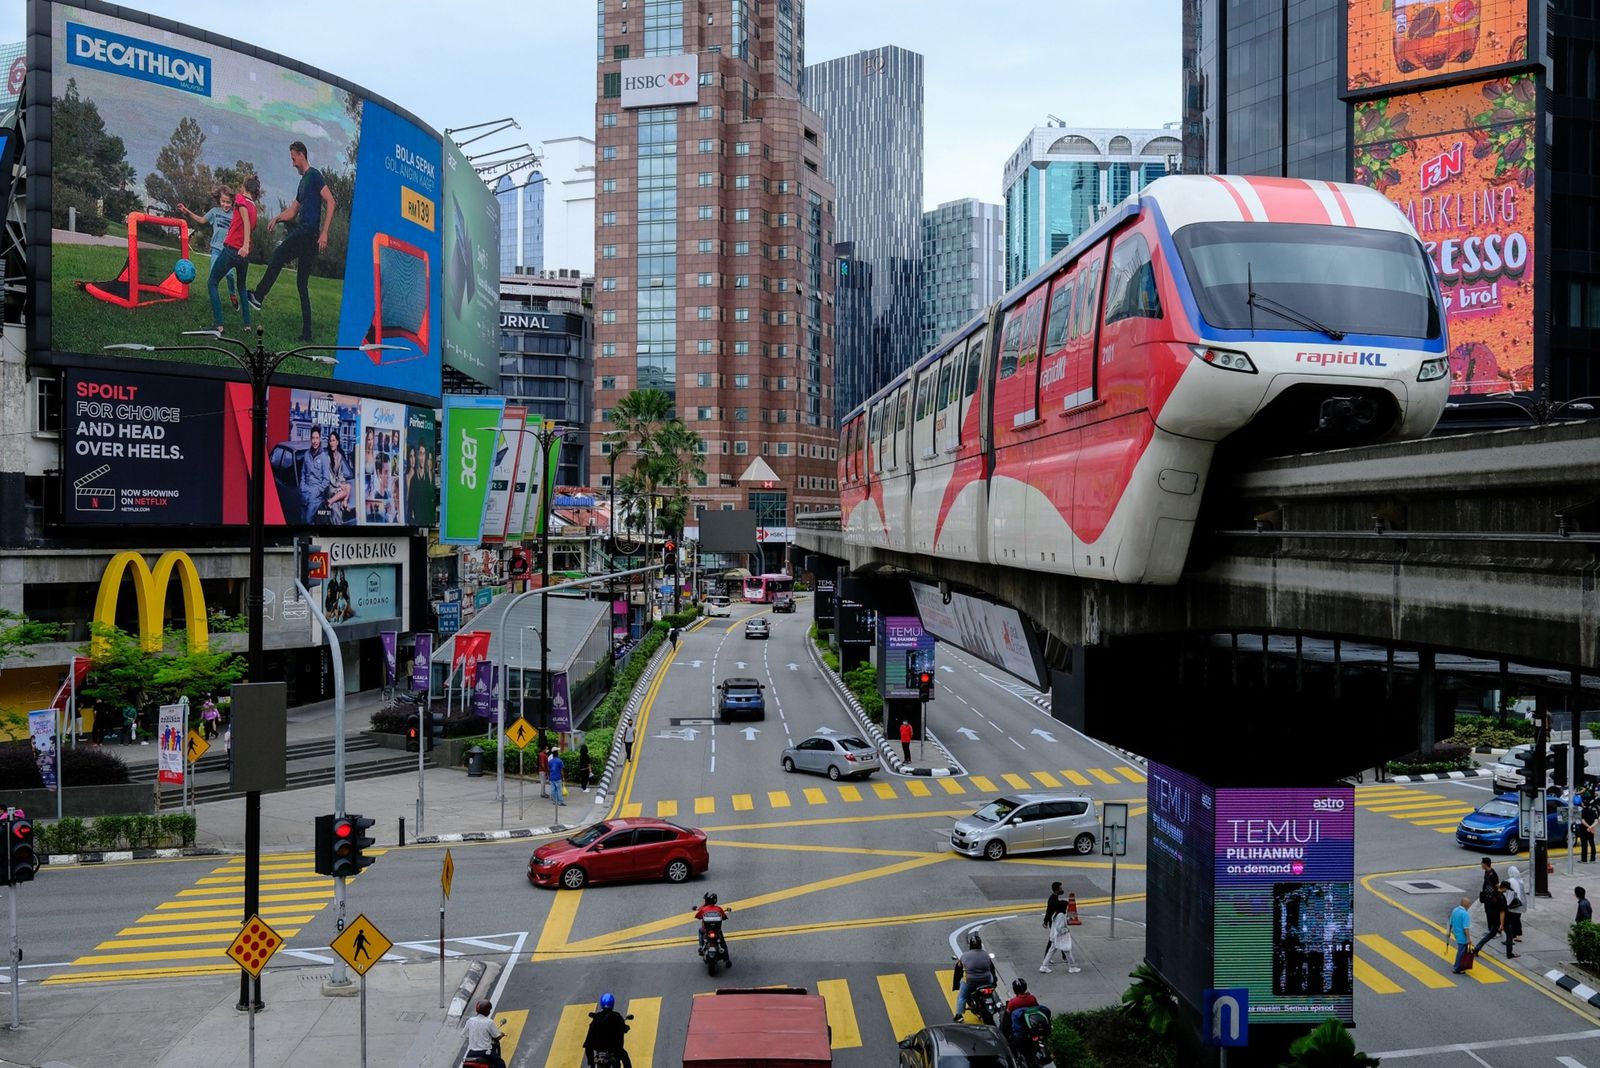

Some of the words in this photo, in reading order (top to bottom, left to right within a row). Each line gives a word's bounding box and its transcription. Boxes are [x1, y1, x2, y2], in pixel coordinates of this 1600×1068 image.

[76, 33, 204, 86] DECATHLON
[624, 74, 666, 91] HSBC
[395, 144, 415, 166] BOLA
[415, 156, 435, 179] SEPAK
[1420, 142, 1463, 191] F&N
[1394, 186, 1517, 232] ARKLING
[1459, 283, 1498, 308] bro!
[1296, 351, 1388, 367] rapidKL
[76, 381, 138, 401] SPOILT
[76, 401, 113, 419] FOR
[116, 403, 180, 422] CHOICE
[310, 398, 337, 413] ALWAYS
[318, 412, 340, 426] MAYBE
[76, 420, 115, 437] AND
[118, 424, 165, 440] HEAD
[75, 440, 124, 457] OVER
[128, 443, 184, 460] HEELS.
[460, 428, 477, 490] acer
[121, 489, 141, 497] NOW
[142, 489, 179, 498] SHOWING
[121, 497, 134, 505] ON
[134, 497, 168, 506] NETFLIX
[330, 542, 397, 561] GIORDANO
[1153, 774, 1190, 824] TEMUI
[1313, 797, 1345, 812] astro
[1226, 819, 1319, 843] TEMUI
[1226, 846, 1304, 860] PILIHANMU
[1226, 864, 1241, 873] on
[1243, 863, 1291, 873] demand
[1327, 944, 1351, 952] THE
